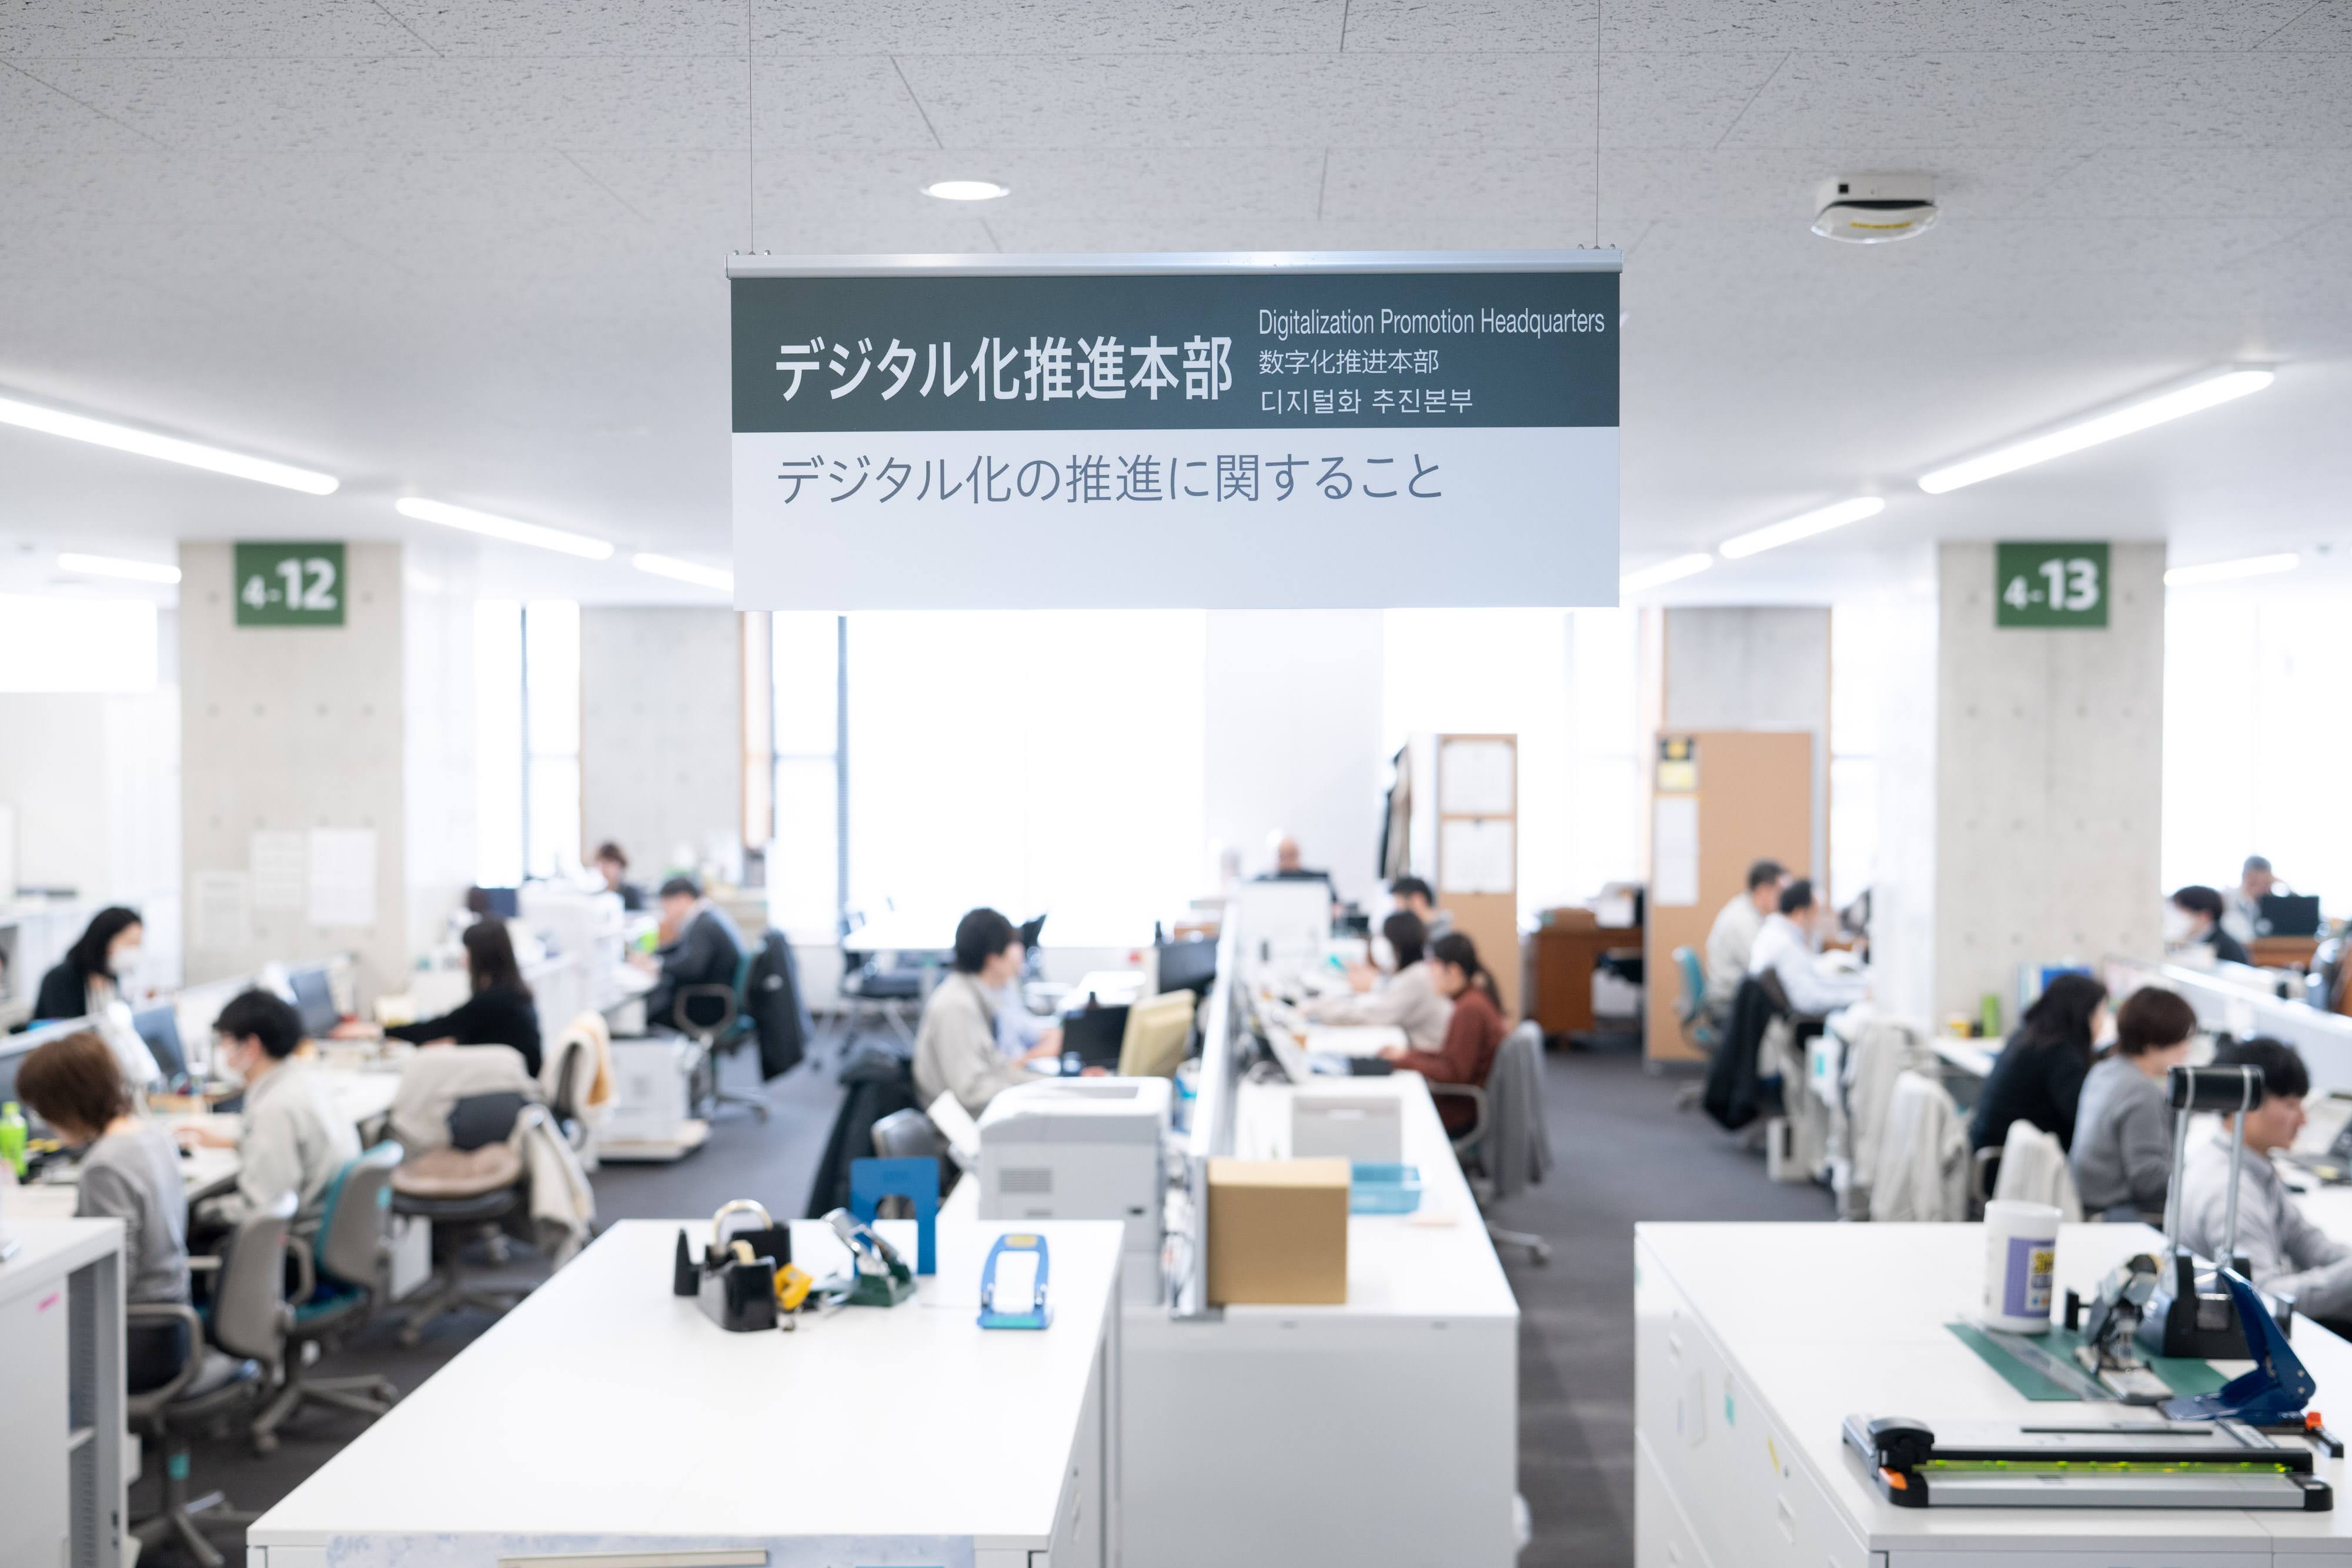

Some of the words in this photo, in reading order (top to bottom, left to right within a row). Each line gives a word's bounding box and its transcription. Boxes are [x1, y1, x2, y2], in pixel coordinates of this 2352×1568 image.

[1259, 309, 1374, 341] Digitalization
[1381, 308, 1475, 334] Promotion
[1481, 307, 1605, 339] Headquarters
[776, 335, 1233, 402] デジタル化推進本部
[1259, 349, 1439, 375] 数字化推进本部
[1261, 389, 1362, 414] 디지털화
[1372, 389, 1474, 414] 추진본부
[778, 453, 1442, 504] デジタル化の推進に関すること
[243, 559, 336, 610] 4-12
[2004, 559, 2099, 610] 4-13
